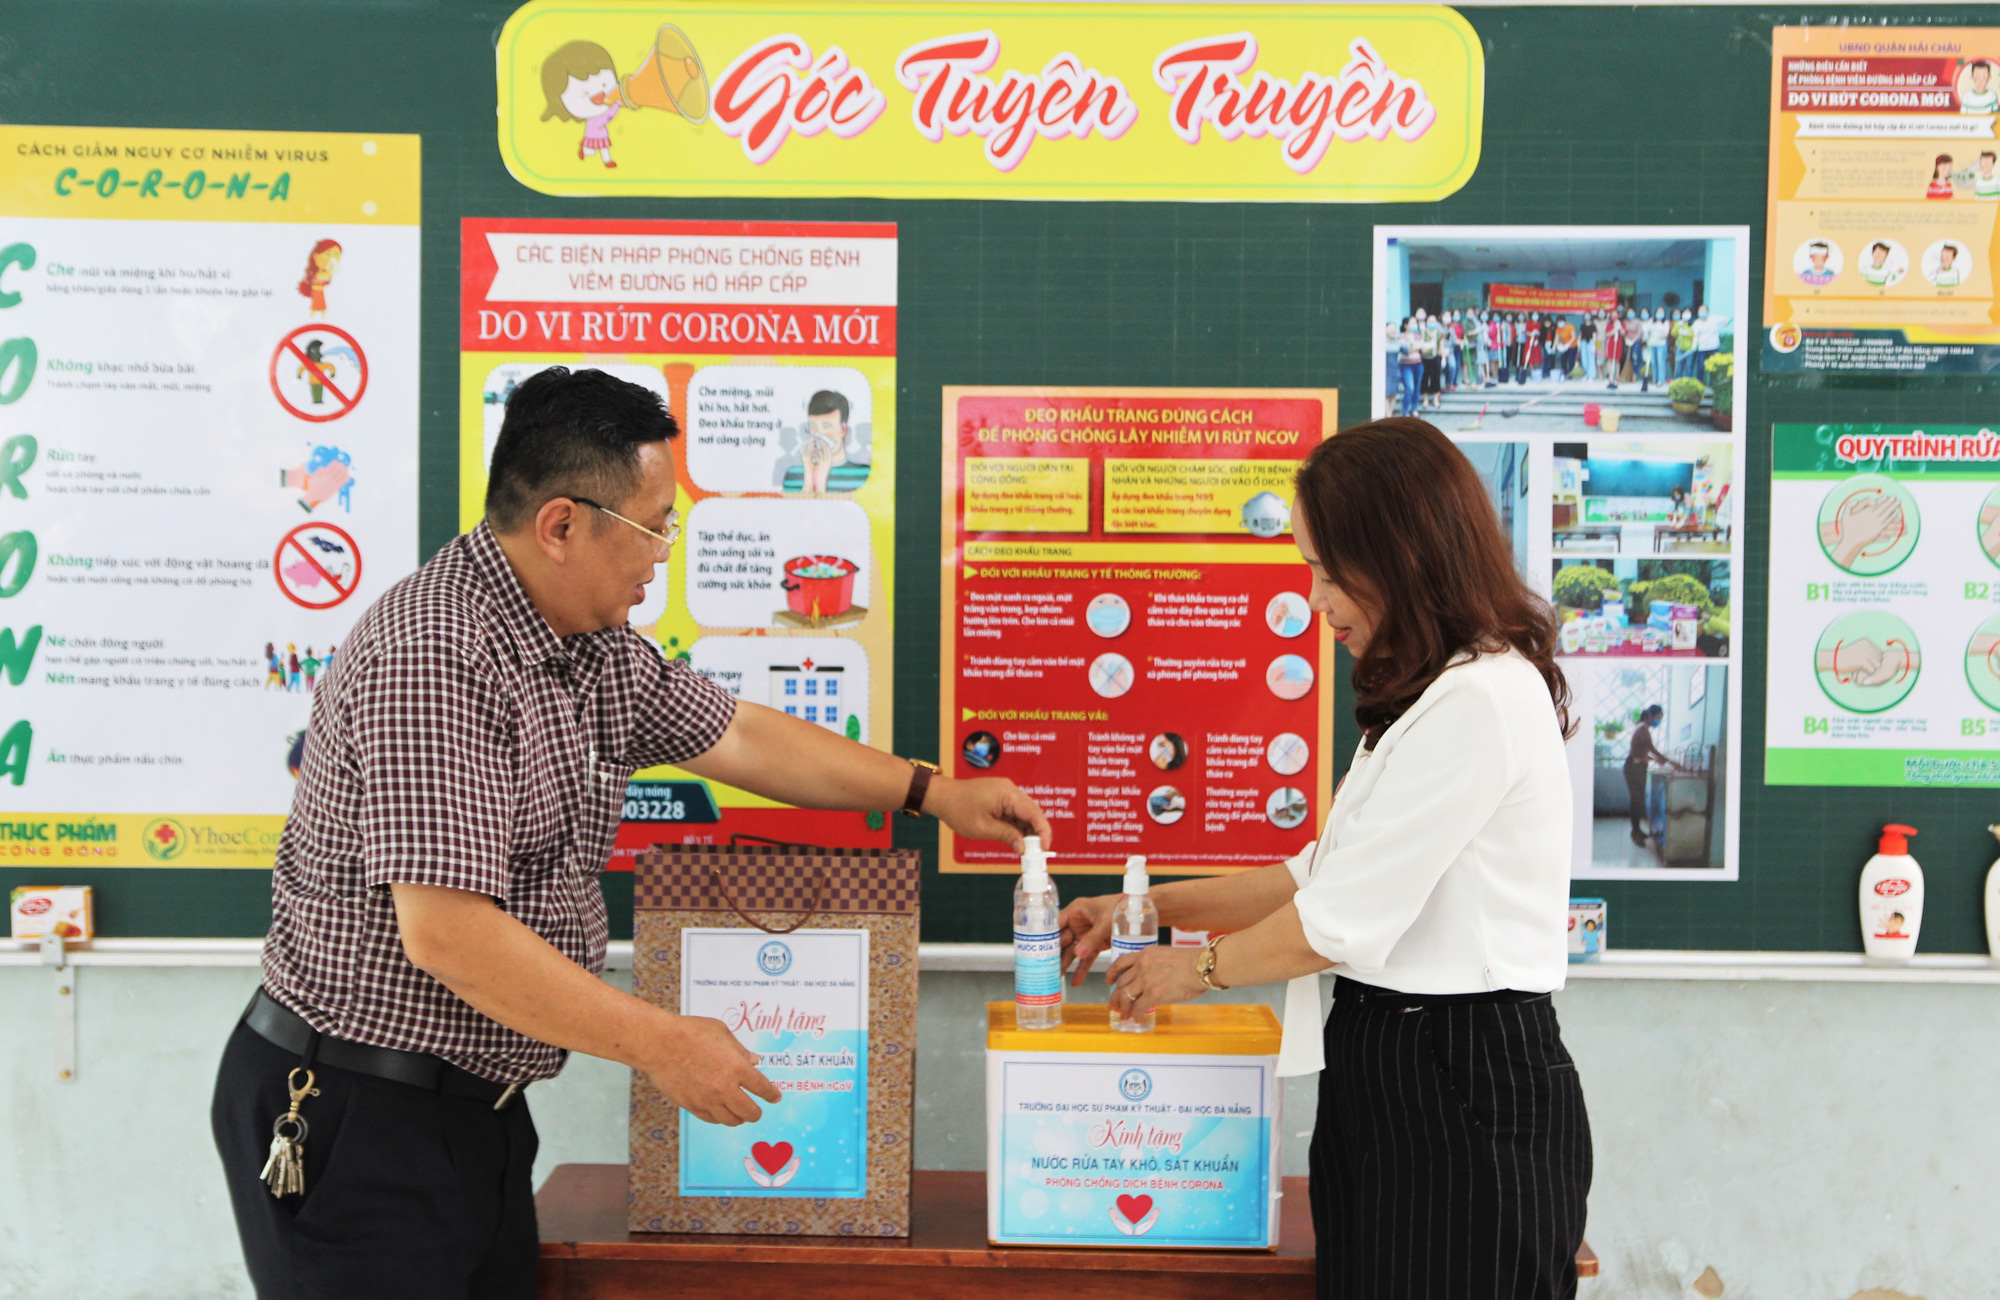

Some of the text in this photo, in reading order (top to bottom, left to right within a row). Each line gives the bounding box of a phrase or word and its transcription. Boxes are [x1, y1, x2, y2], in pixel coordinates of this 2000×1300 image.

[712, 36, 1428, 160] Góc Tuyên Truyền
[1788, 90, 1950, 107] DO VI RÚT CORONA MỚI
[16, 143, 328, 162] CÁCH GIẢM NGUY CƠ NHIỄM VIRUS
[54, 167, 291, 202] C-O-R-O-N-A
[516, 243, 860, 268] CÁC BIỆN PHÁP PHÒNG CHỐNG BỆNH
[568, 270, 613, 291] VIÊM
[619, 272, 686, 292] ĐƯỜNG
[724, 272, 763, 292] HẤP
[769, 272, 807, 293] CẤP
[478, 305, 880, 344] DO VI RÚT CORONA MỚI
[1024, 406, 1253, 424] ĐEO KHẨU TRANG ĐÚNG CÁCH
[978, 425, 1299, 445] ĐỂ PHÒNG CHỐNG LÂY NHIỄM VI RÚT NCOV
[1838, 437, 1886, 460] QUY
[1888, 434, 1956, 457] TRÌNH
[1807, 583, 1830, 601] B1
[1964, 581, 1989, 600] B2
[1804, 716, 1829, 735] B4
[1961, 718, 1987, 736] B5
[625, 784, 671, 800] dây nóng
[721, 1001, 827, 1039] Kính tặng
[768, 1050, 793, 1069] KHÔ,
[795, 1051, 816, 1066] SÁT
[818, 1048, 854, 1067] KHUẨN
[1088, 1119, 1183, 1154] Kính tặng
[1031, 1153, 1239, 1173] NƯỚC RỬA TAY KHÔ, SÁT KHUẨN
[1045, 1176, 1224, 1190] PHÒNG CHỐNG DỊCH BỆNH CORONA
